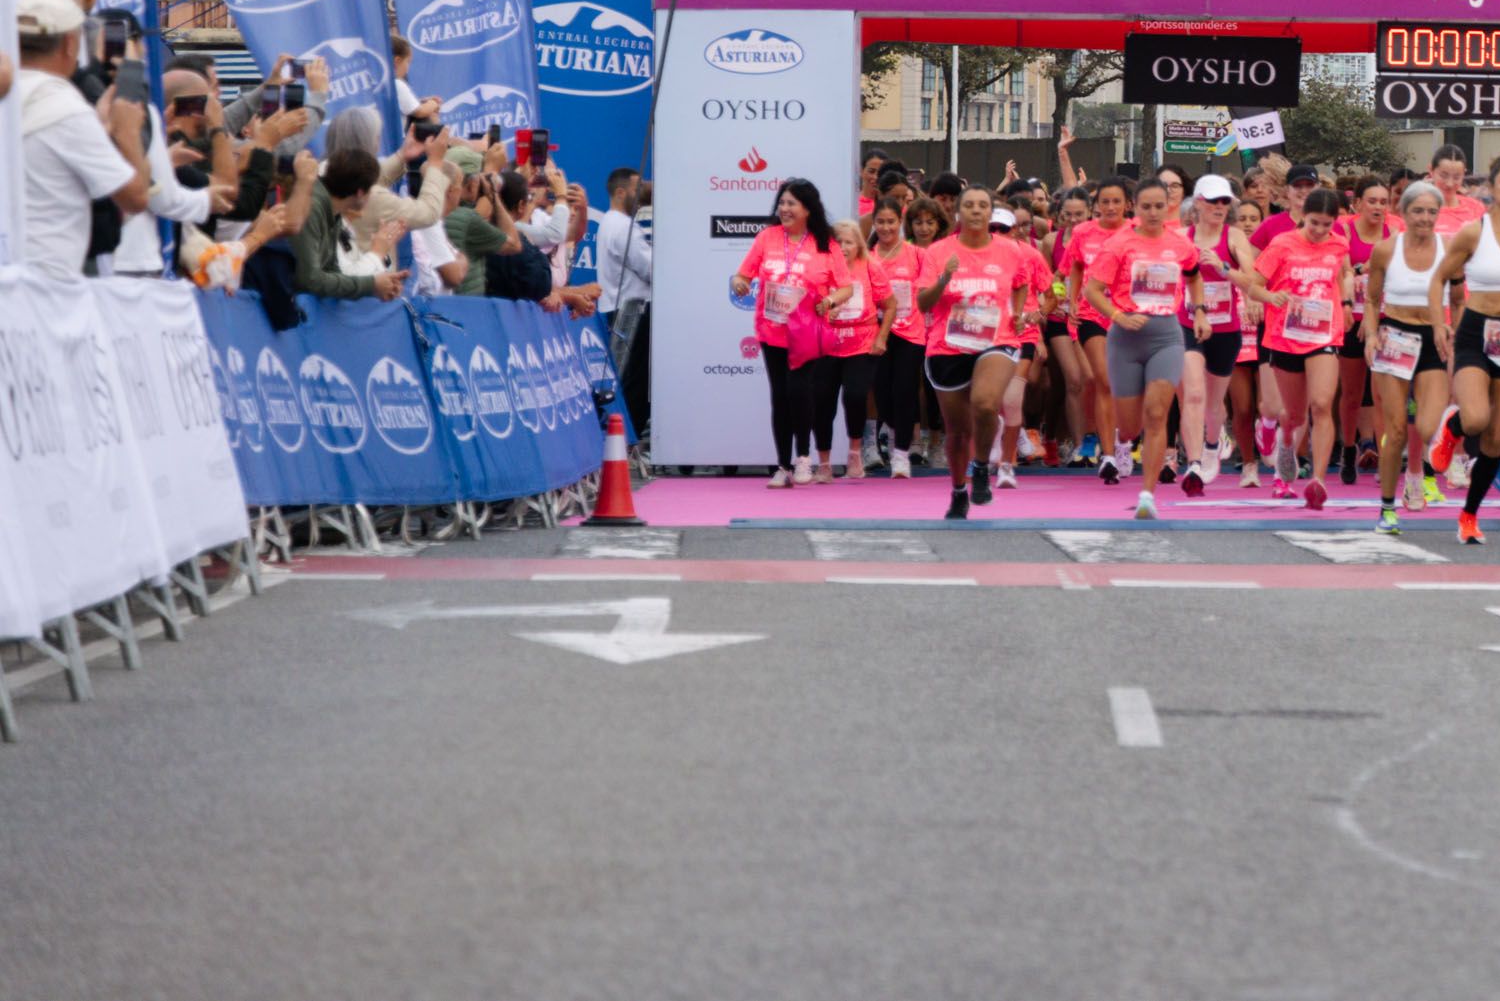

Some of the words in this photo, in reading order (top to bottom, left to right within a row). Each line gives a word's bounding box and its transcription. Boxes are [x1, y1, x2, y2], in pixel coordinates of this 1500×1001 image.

[538, 30, 589, 43] ENTRAL
[596, 36, 650, 50] LECHERA
[537, 43, 650, 78] TURIANA
[712, 46, 797, 63] ASTURIANA
[1152, 56, 1276, 86] OYSHO
[702, 99, 805, 120] OYSHO
[710, 176, 779, 191] Santand
